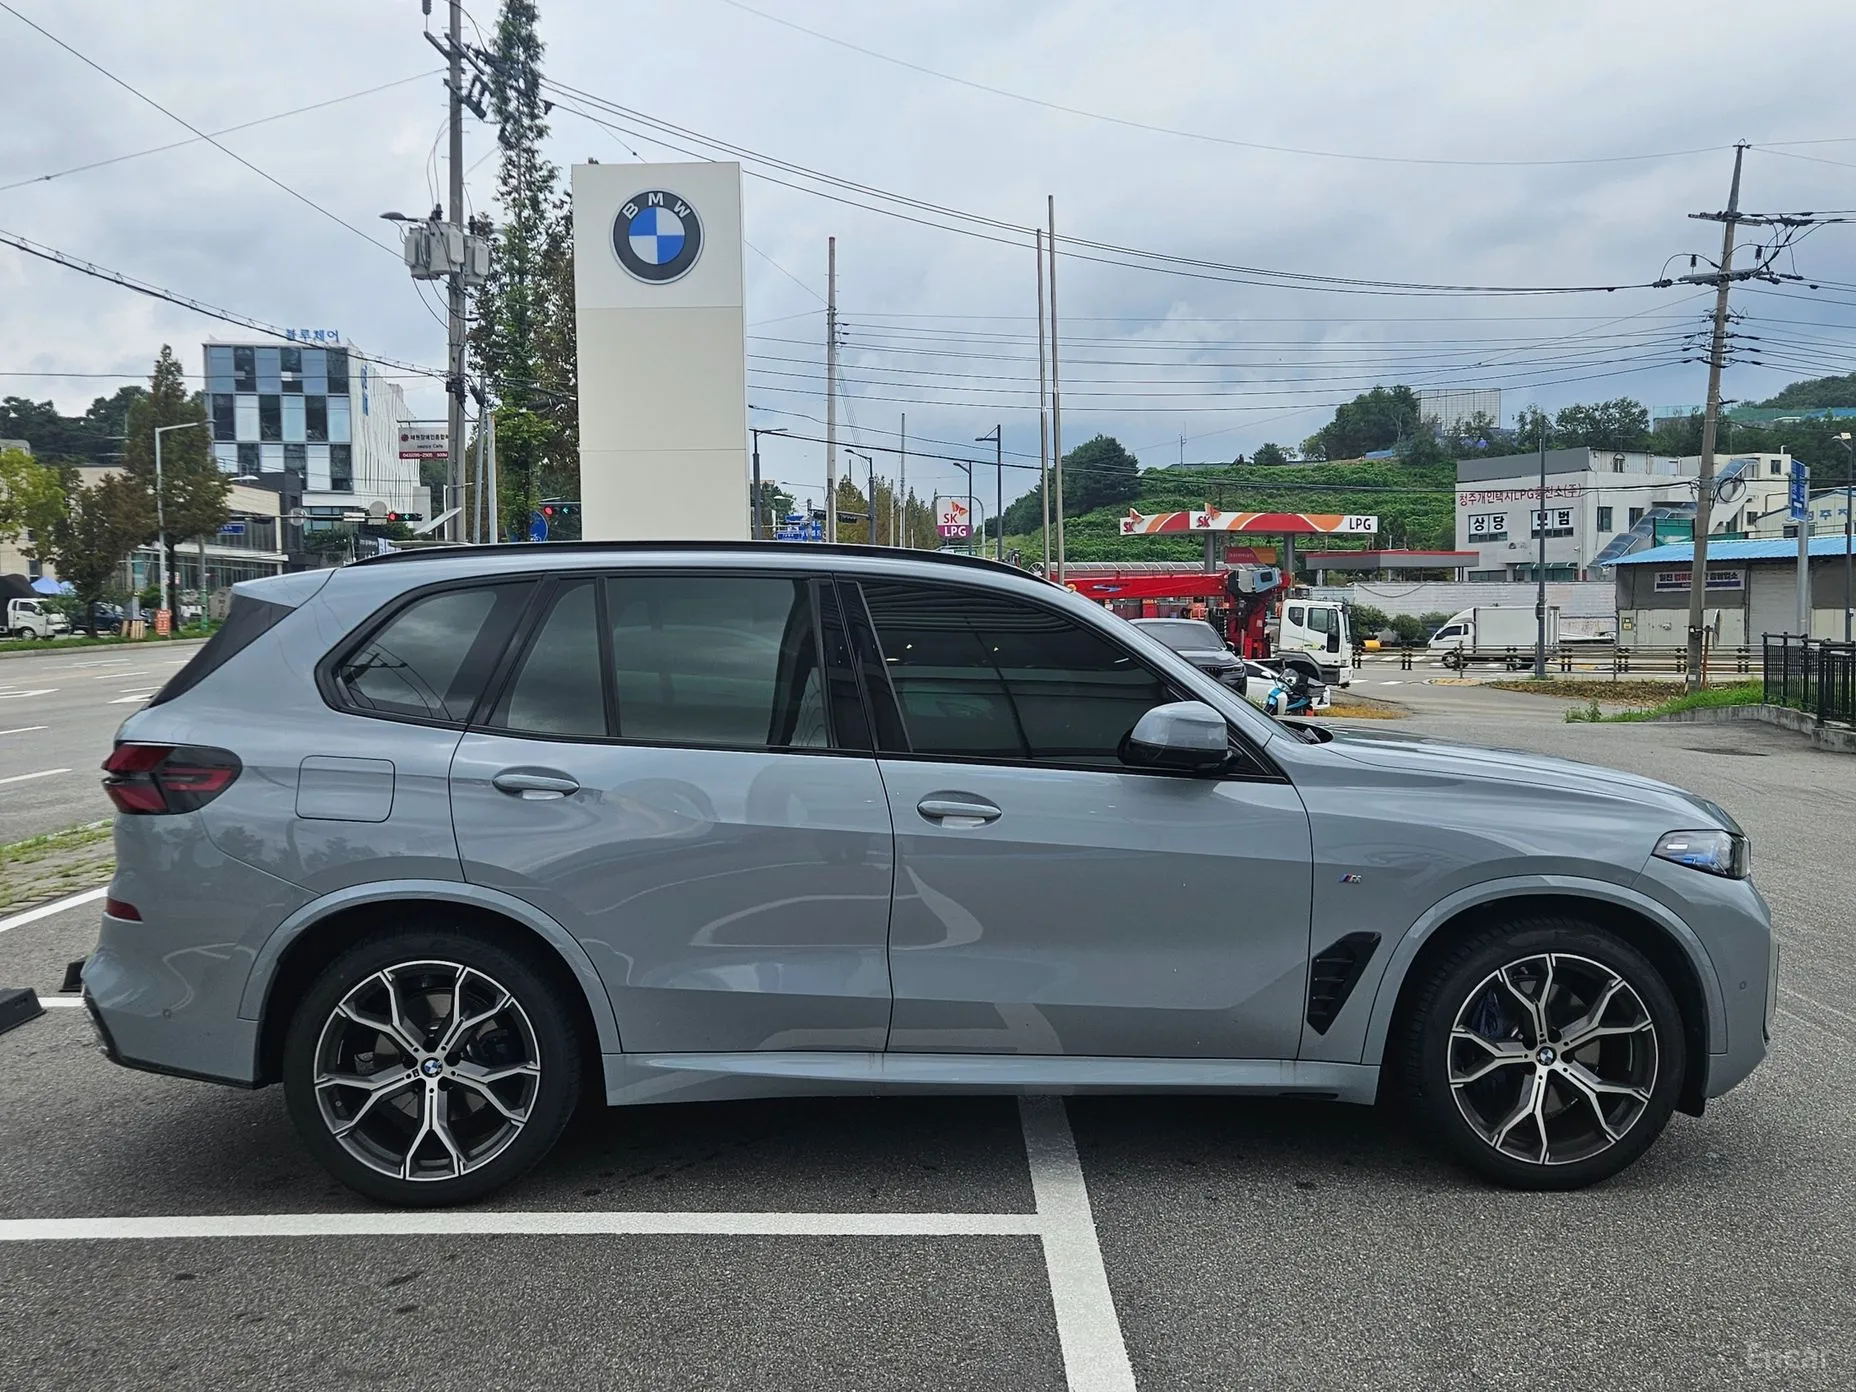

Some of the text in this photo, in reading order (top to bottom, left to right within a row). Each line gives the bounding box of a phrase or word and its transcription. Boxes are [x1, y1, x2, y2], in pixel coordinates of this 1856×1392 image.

[622, 192, 691, 220] BMW
[943, 512, 958, 524] SK
[1197, 515, 1210, 528] SK
[1348, 517, 1372, 531] LPG
[1473, 515, 1505, 532] 상당
[944, 525, 967, 537] LPG
[1123, 521, 1136, 533] SK
